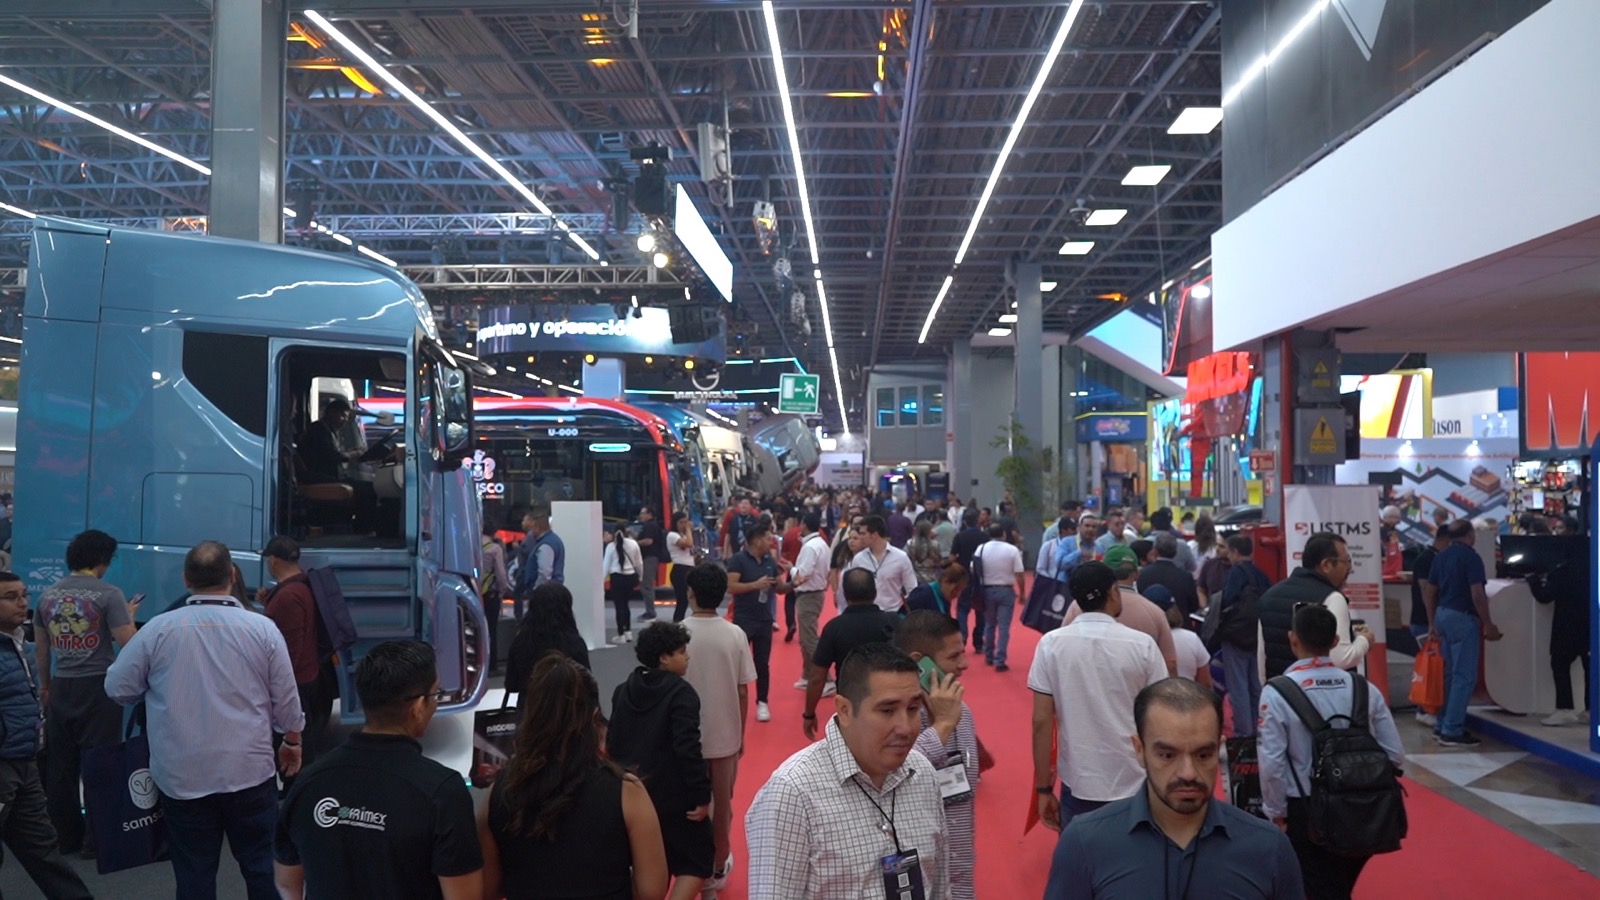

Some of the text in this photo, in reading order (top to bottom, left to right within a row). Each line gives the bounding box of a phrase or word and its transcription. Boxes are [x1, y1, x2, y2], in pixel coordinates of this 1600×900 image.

[477, 319, 631, 342] portuno y operació
[548, 428, 579, 437] U-000
[1432, 419, 1462, 435] lison
[475, 482, 505, 494] ISCO
